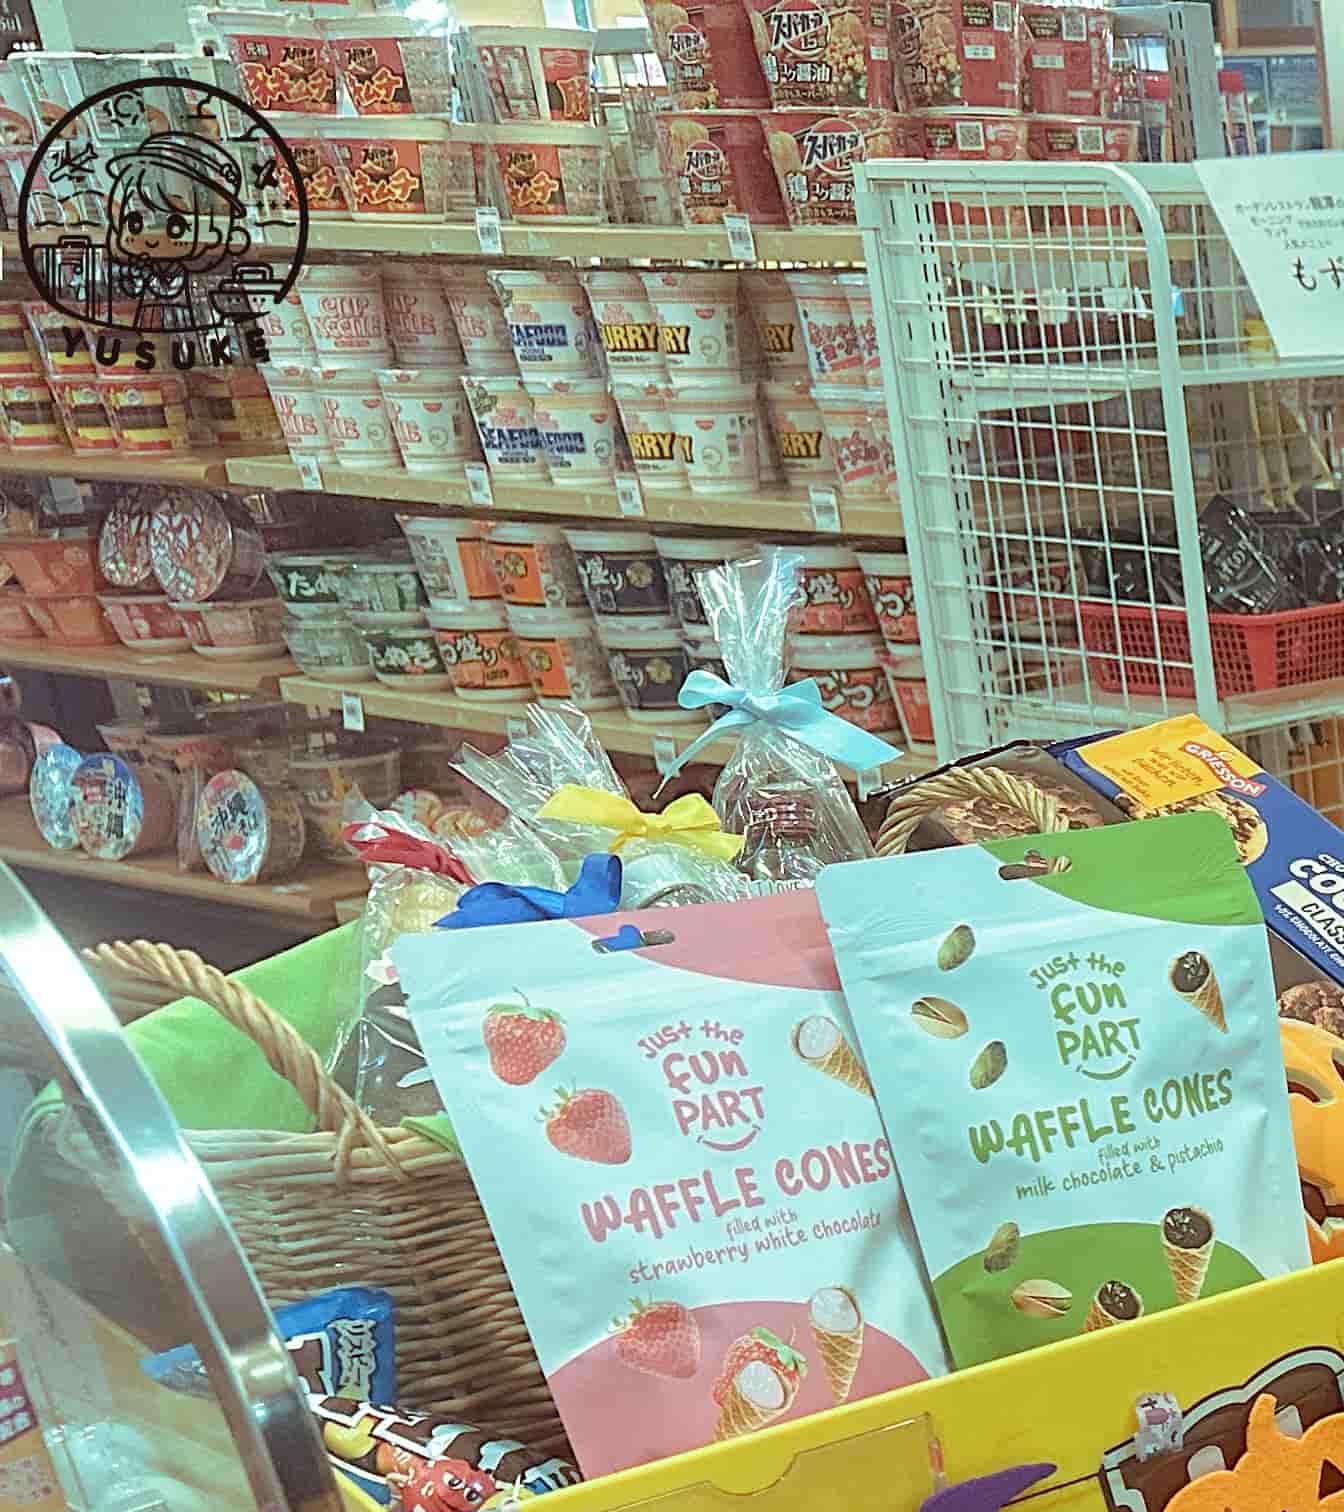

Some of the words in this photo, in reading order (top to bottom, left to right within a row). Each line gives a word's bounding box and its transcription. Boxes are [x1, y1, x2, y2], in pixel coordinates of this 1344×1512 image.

[1184, 743, 1262, 796] GRIESSON
[1087, 951, 1128, 979] the
[700, 1020, 746, 1047] the
[1056, 1017, 1141, 1067] PART
[673, 1086, 767, 1137] PART
[968, 1094, 1137, 1164] WAFFLE
[1143, 1068, 1234, 1123] CONES
[1016, 1178, 1057, 1201] milk
[1062, 1159, 1144, 1194] chocolate
[1149, 1154, 1166, 1175] &
[1167, 1138, 1225, 1174] pistachio
[1098, 1144, 1131, 1165] filled
[1132, 1135, 1162, 1155] with
[580, 1166, 766, 1243] WAFFLE
[774, 1138, 893, 1197] CONES
[725, 1213, 760, 1241] filled
[763, 1208, 799, 1233] with
[629, 1241, 750, 1285] strawberry
[755, 1226, 809, 1255] white
